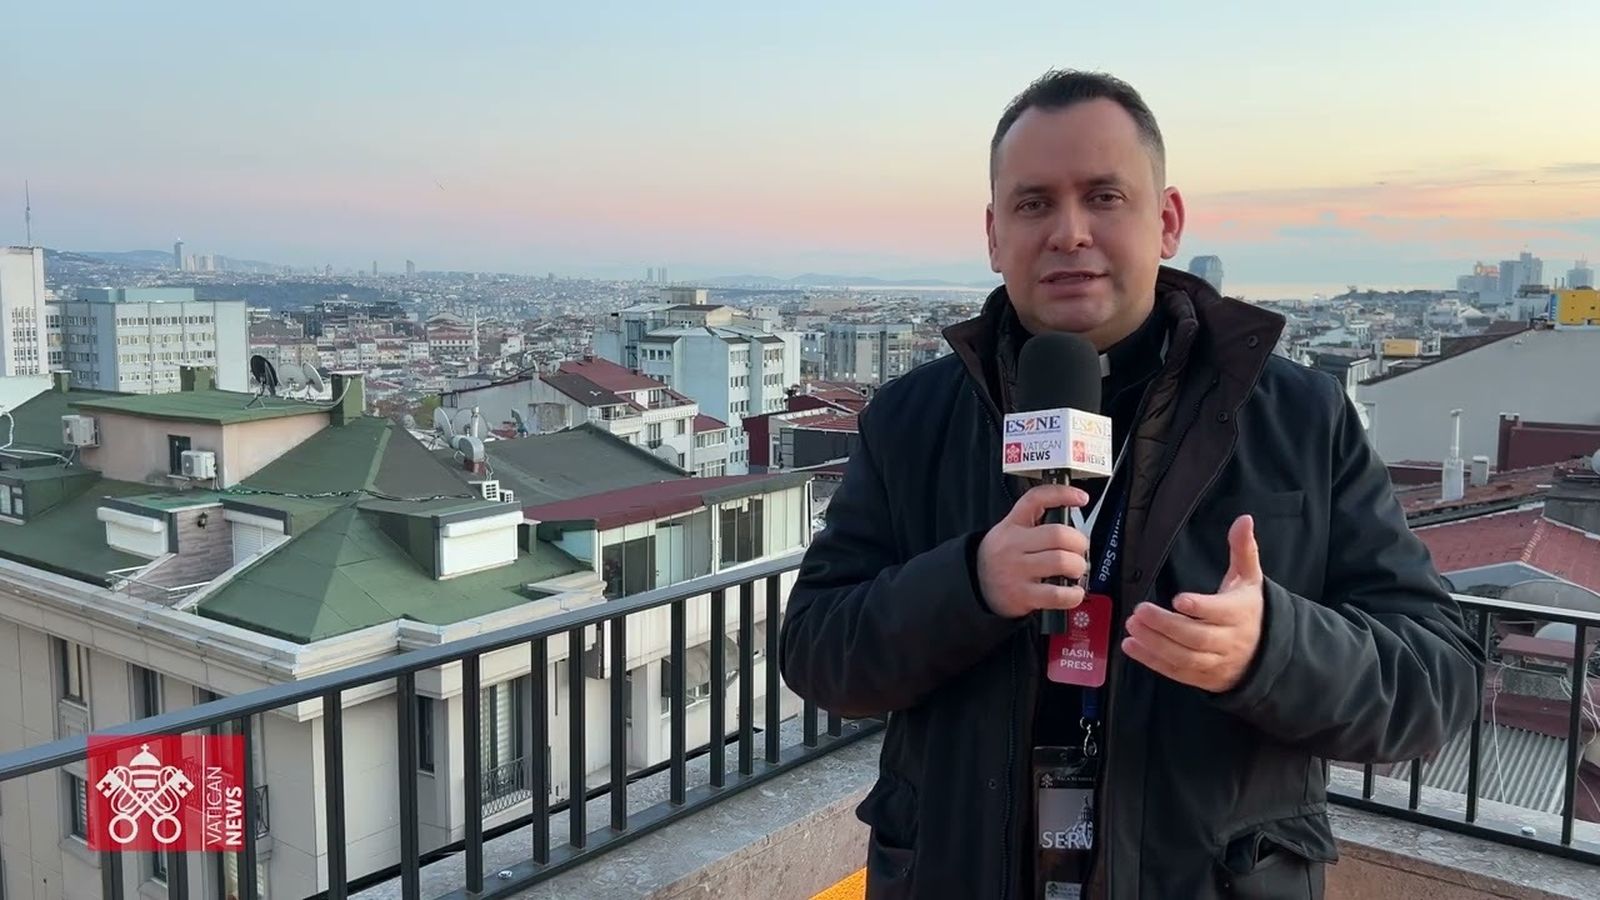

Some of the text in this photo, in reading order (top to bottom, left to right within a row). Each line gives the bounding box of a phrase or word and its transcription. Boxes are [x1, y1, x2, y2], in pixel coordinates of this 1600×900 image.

[1023, 440, 1062, 452] VATICAN
[1022, 450, 1051, 462] NEWS
[1098, 550, 1117, 582] Sede
[1061, 647, 1095, 660] BASIN
[1060, 659, 1094, 672] PRESS
